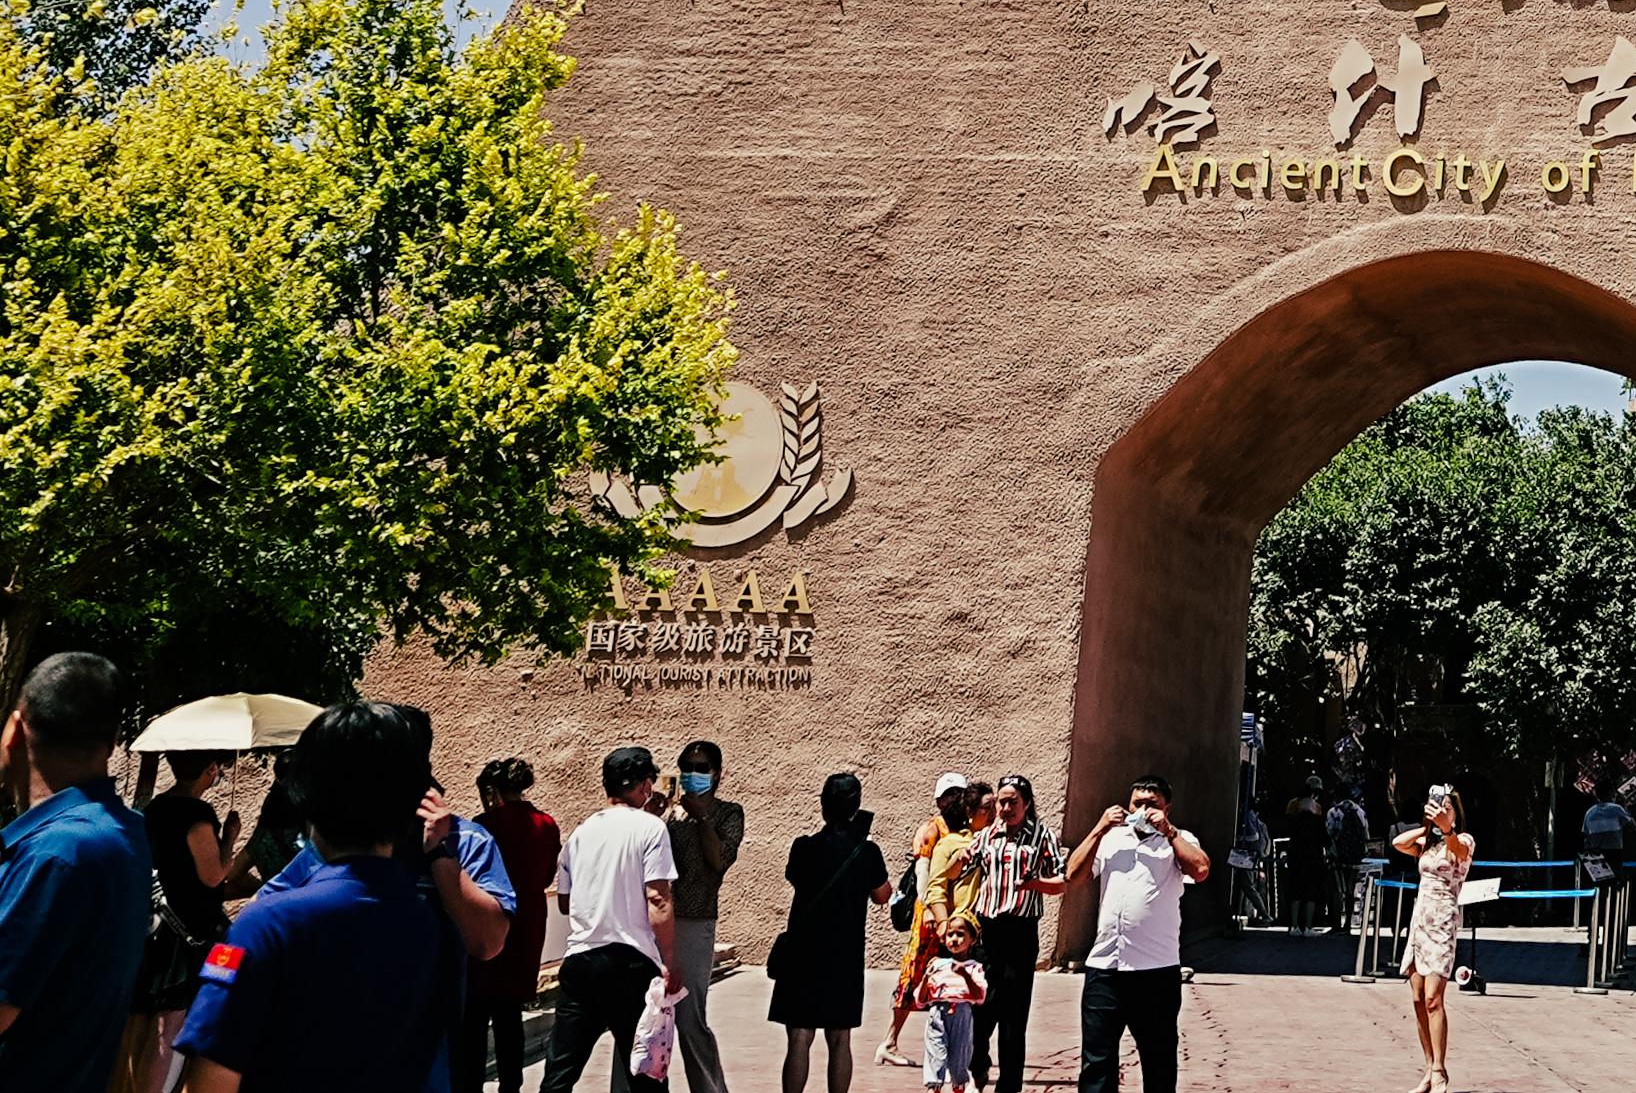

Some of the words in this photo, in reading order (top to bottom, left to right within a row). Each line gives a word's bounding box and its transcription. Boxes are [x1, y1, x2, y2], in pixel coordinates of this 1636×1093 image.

[1140, 143, 1368, 192] Ancient
[1382, 148, 1506, 203] City
[1541, 149, 1601, 193] of
[586, 619, 814, 659] 国家级旅游景区
[717, 667, 810, 682] ATTRACTION
